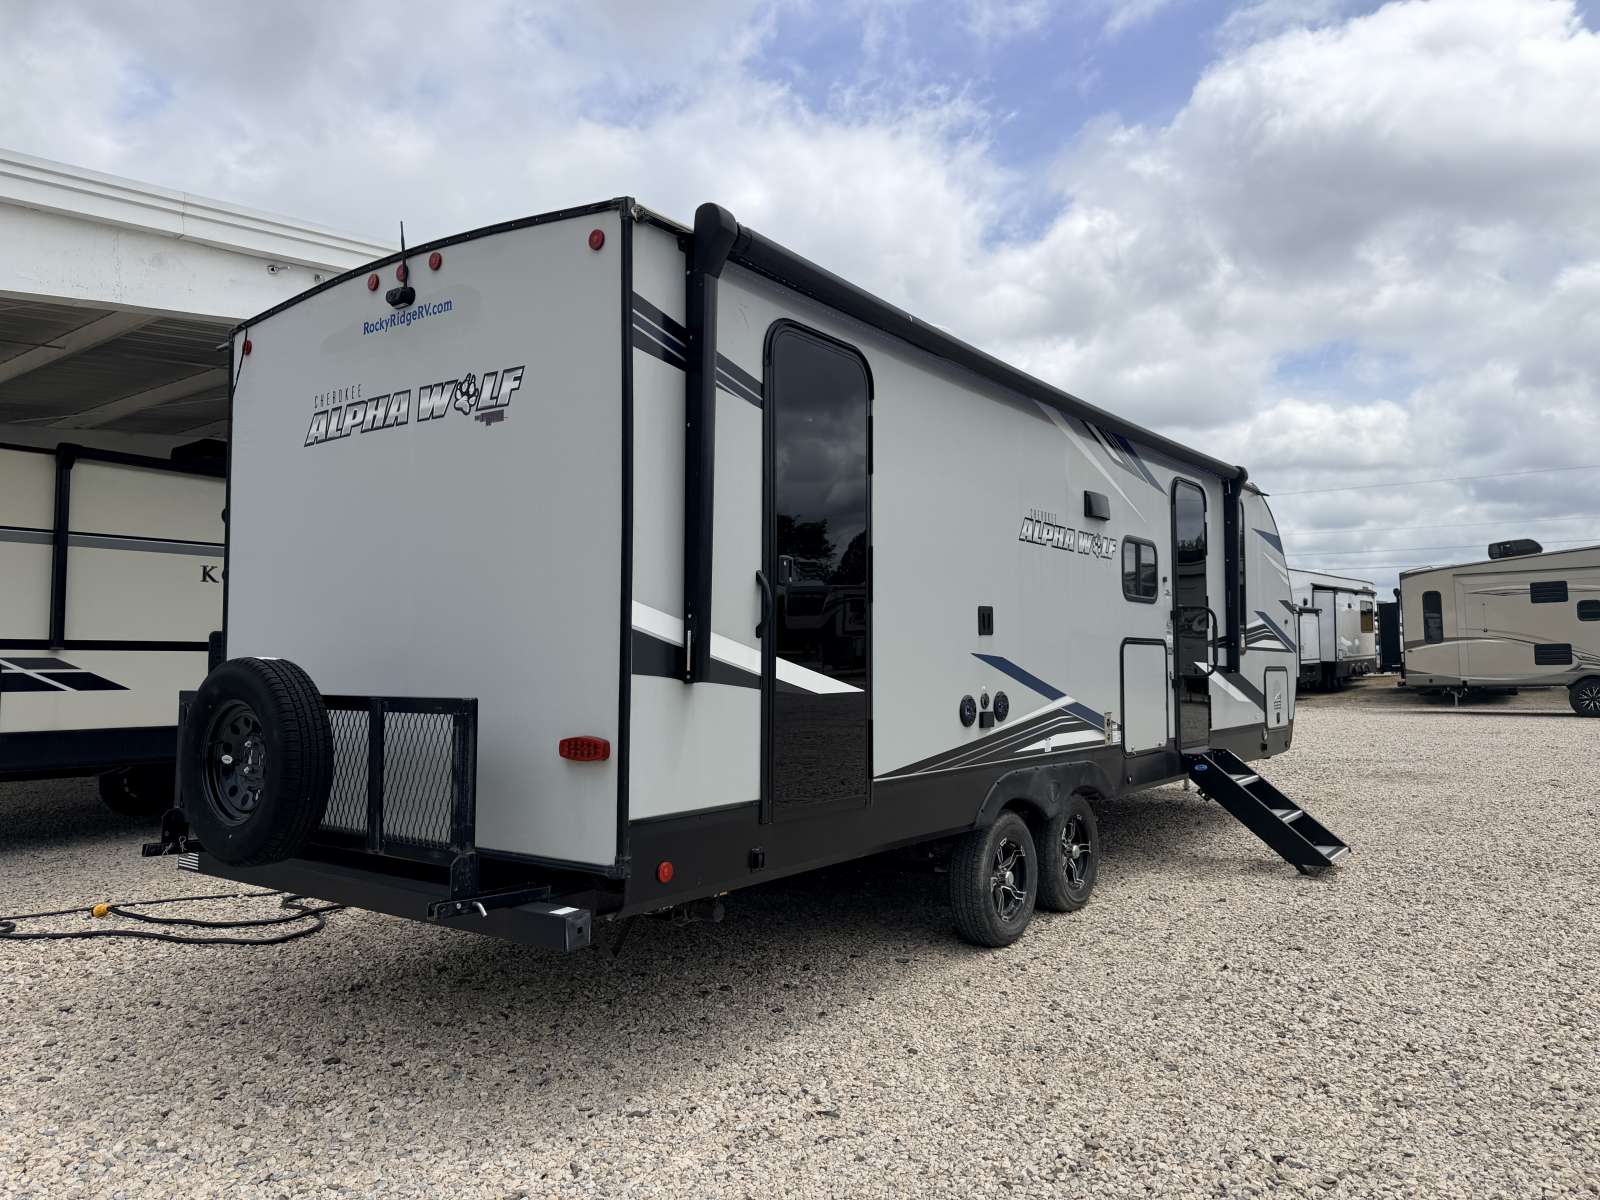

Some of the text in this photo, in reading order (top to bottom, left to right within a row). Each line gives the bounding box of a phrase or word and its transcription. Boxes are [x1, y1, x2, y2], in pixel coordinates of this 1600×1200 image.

[363, 299, 453, 335] RockyRidgeRV.com
[314, 384, 361, 408] CHEROKEE
[304, 389, 411, 447] ALPHA
[1018, 516, 1075, 552] ALPHA
